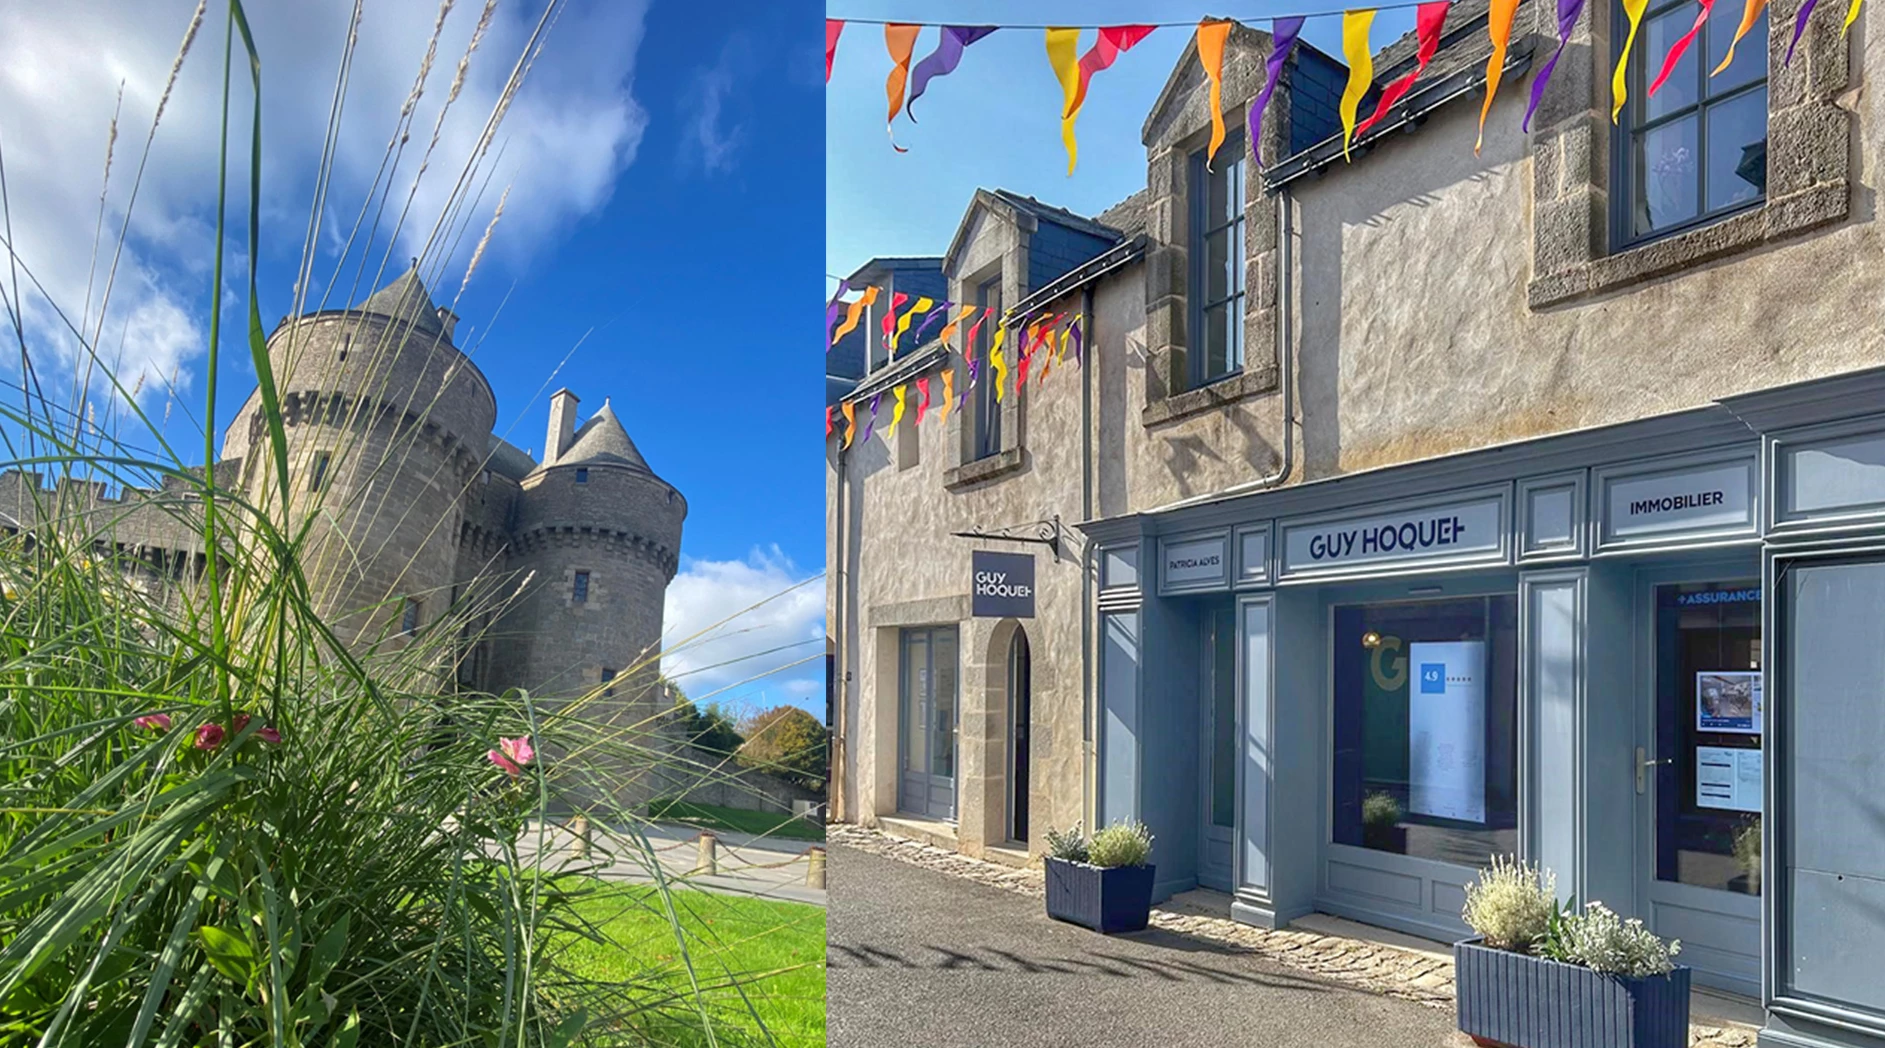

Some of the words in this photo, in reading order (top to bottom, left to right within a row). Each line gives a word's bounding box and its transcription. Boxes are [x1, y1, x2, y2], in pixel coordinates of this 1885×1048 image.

[1630, 491, 1724, 515] IMMOBILIER
[1310, 530, 1358, 560] GUY
[1169, 559, 1198, 569] PATRICIA
[1199, 555, 1220, 566] ALVES
[975, 571, 1007, 584] GUY
